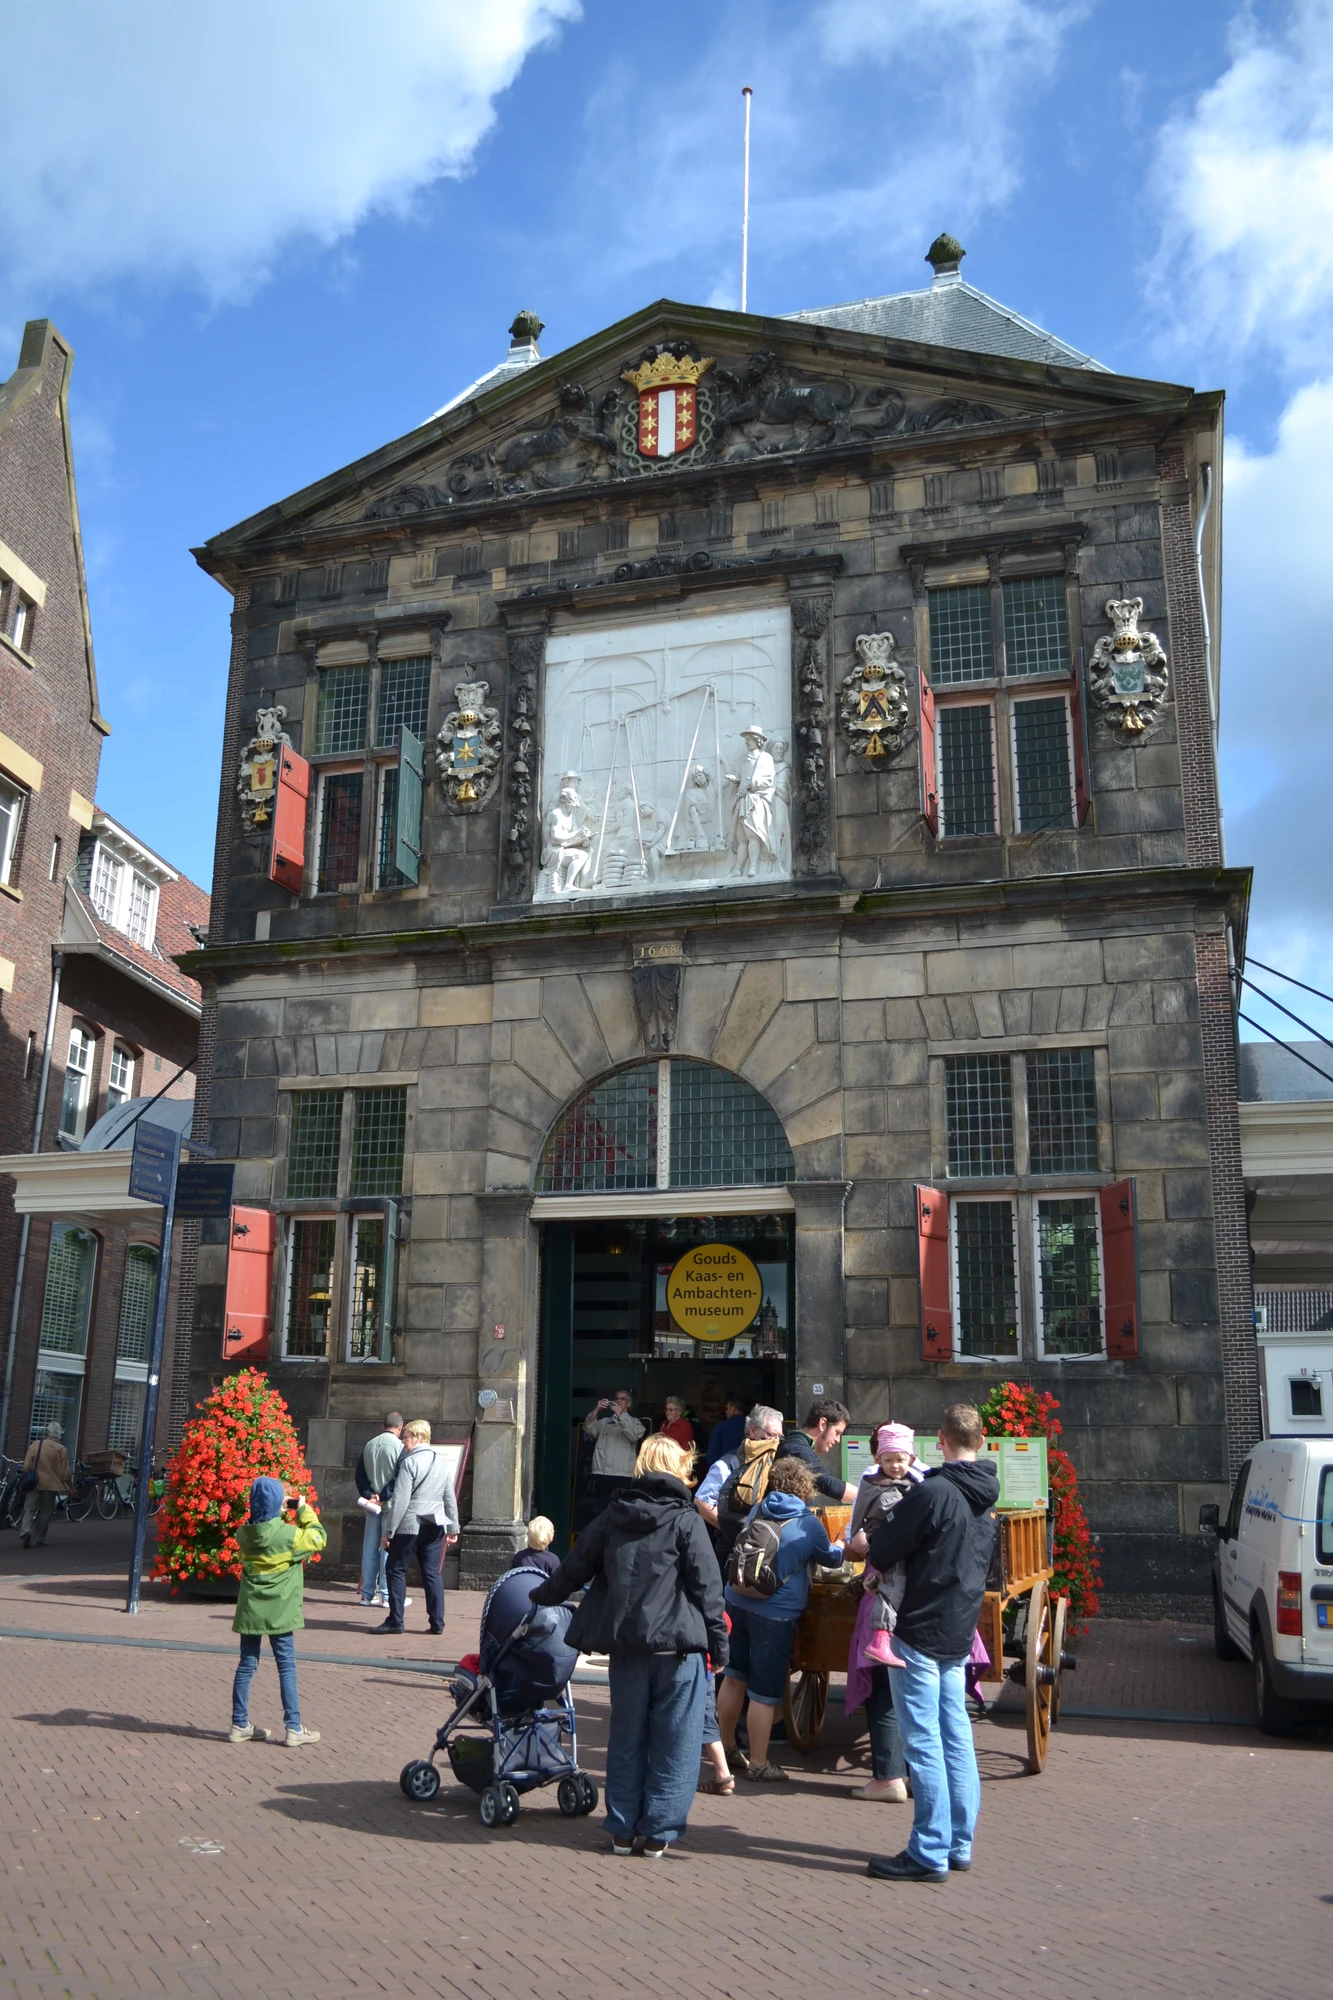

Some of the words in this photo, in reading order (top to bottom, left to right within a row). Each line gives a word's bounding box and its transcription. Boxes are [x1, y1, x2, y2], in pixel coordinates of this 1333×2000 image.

[640, 944, 677, 958] 1668
[137, 1143, 166, 1159] Museumhavn
[693, 1252, 737, 1265] Gouds
[685, 1271, 723, 1282] Kaas-
[727, 1272, 744, 1282] en
[672, 1286, 758, 1300] Ambachten-
[685, 1305, 744, 1317] museum
[814, 1385, 823, 1393] 35
